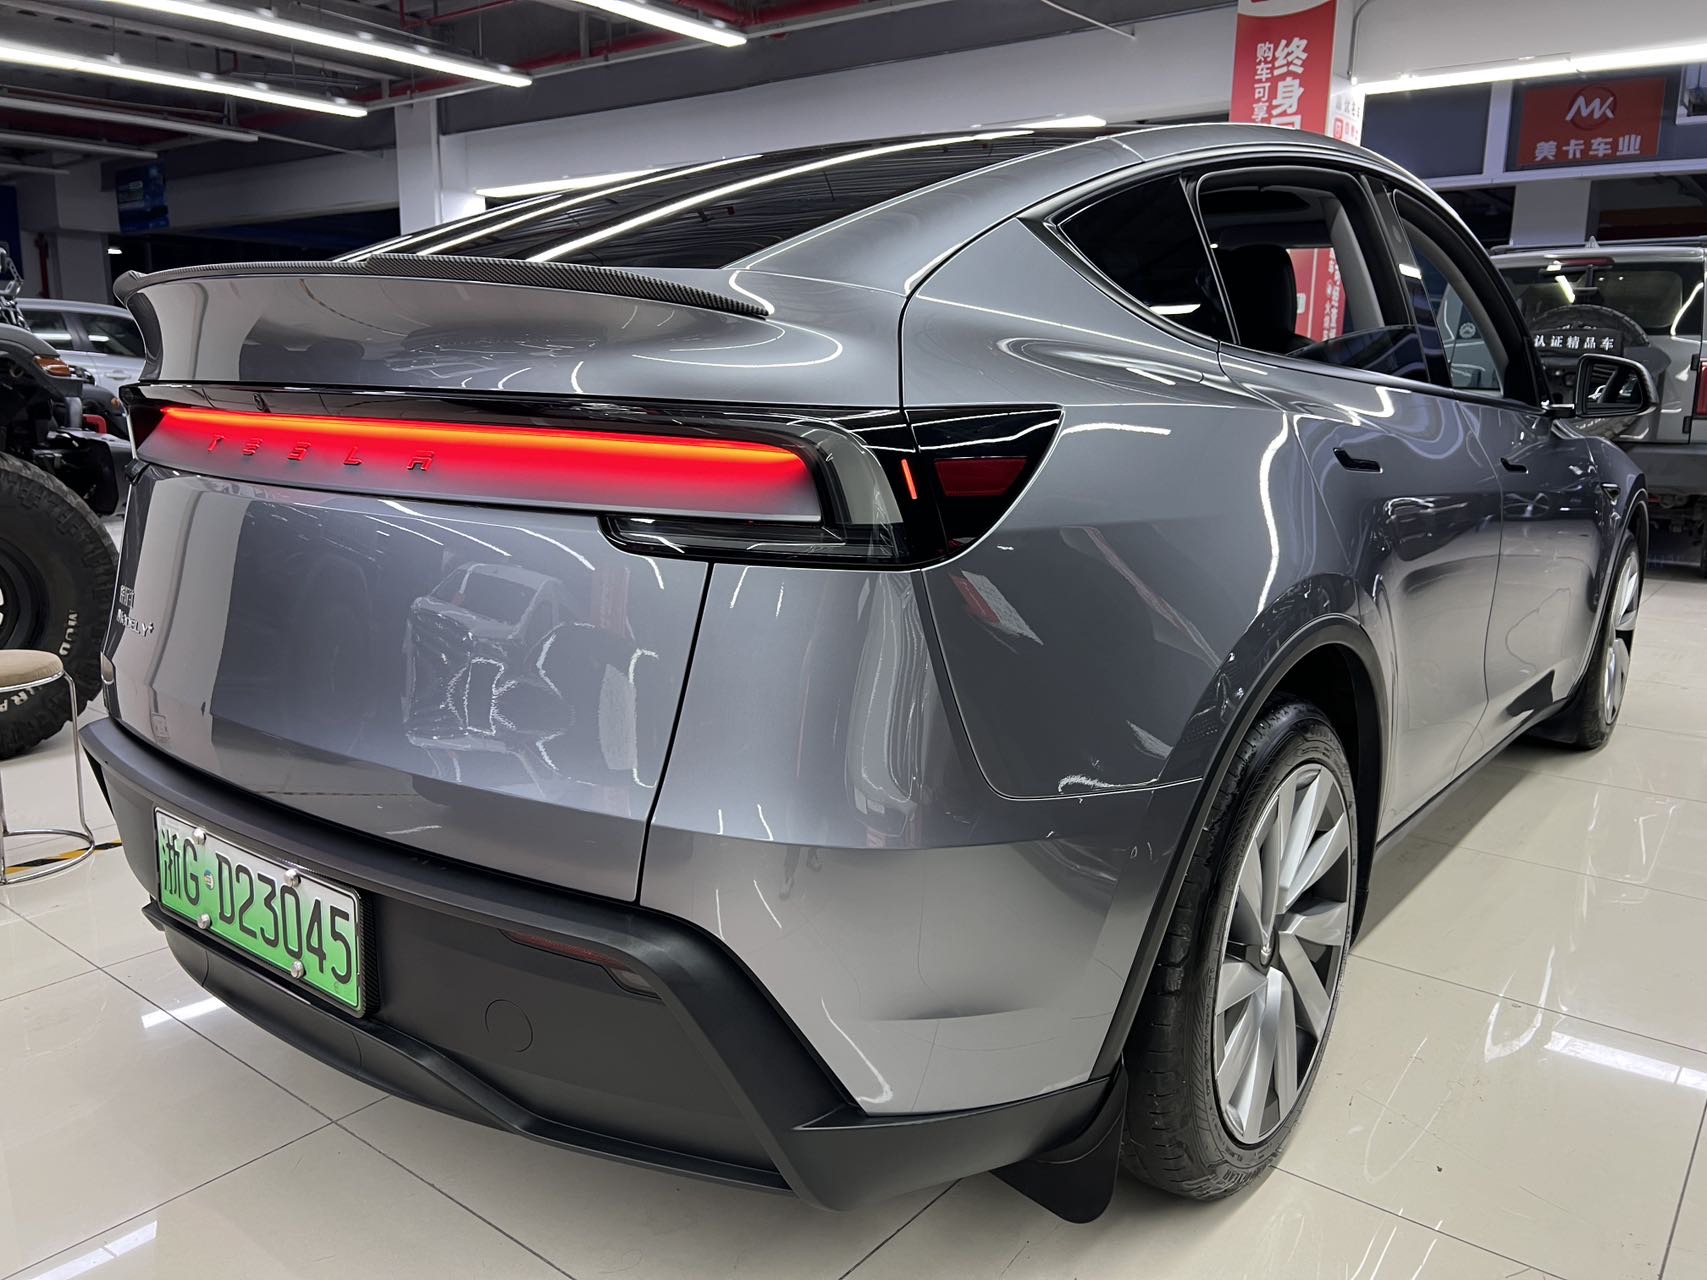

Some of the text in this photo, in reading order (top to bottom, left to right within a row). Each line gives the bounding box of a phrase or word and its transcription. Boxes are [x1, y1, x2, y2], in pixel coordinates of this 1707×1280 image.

[1251, 41, 1274, 122] 购车可享
[1535, 134, 1642, 161] 美卡车业
[1534, 334, 1614, 351] 认证精品车
[207, 434, 435, 472] TESLA
